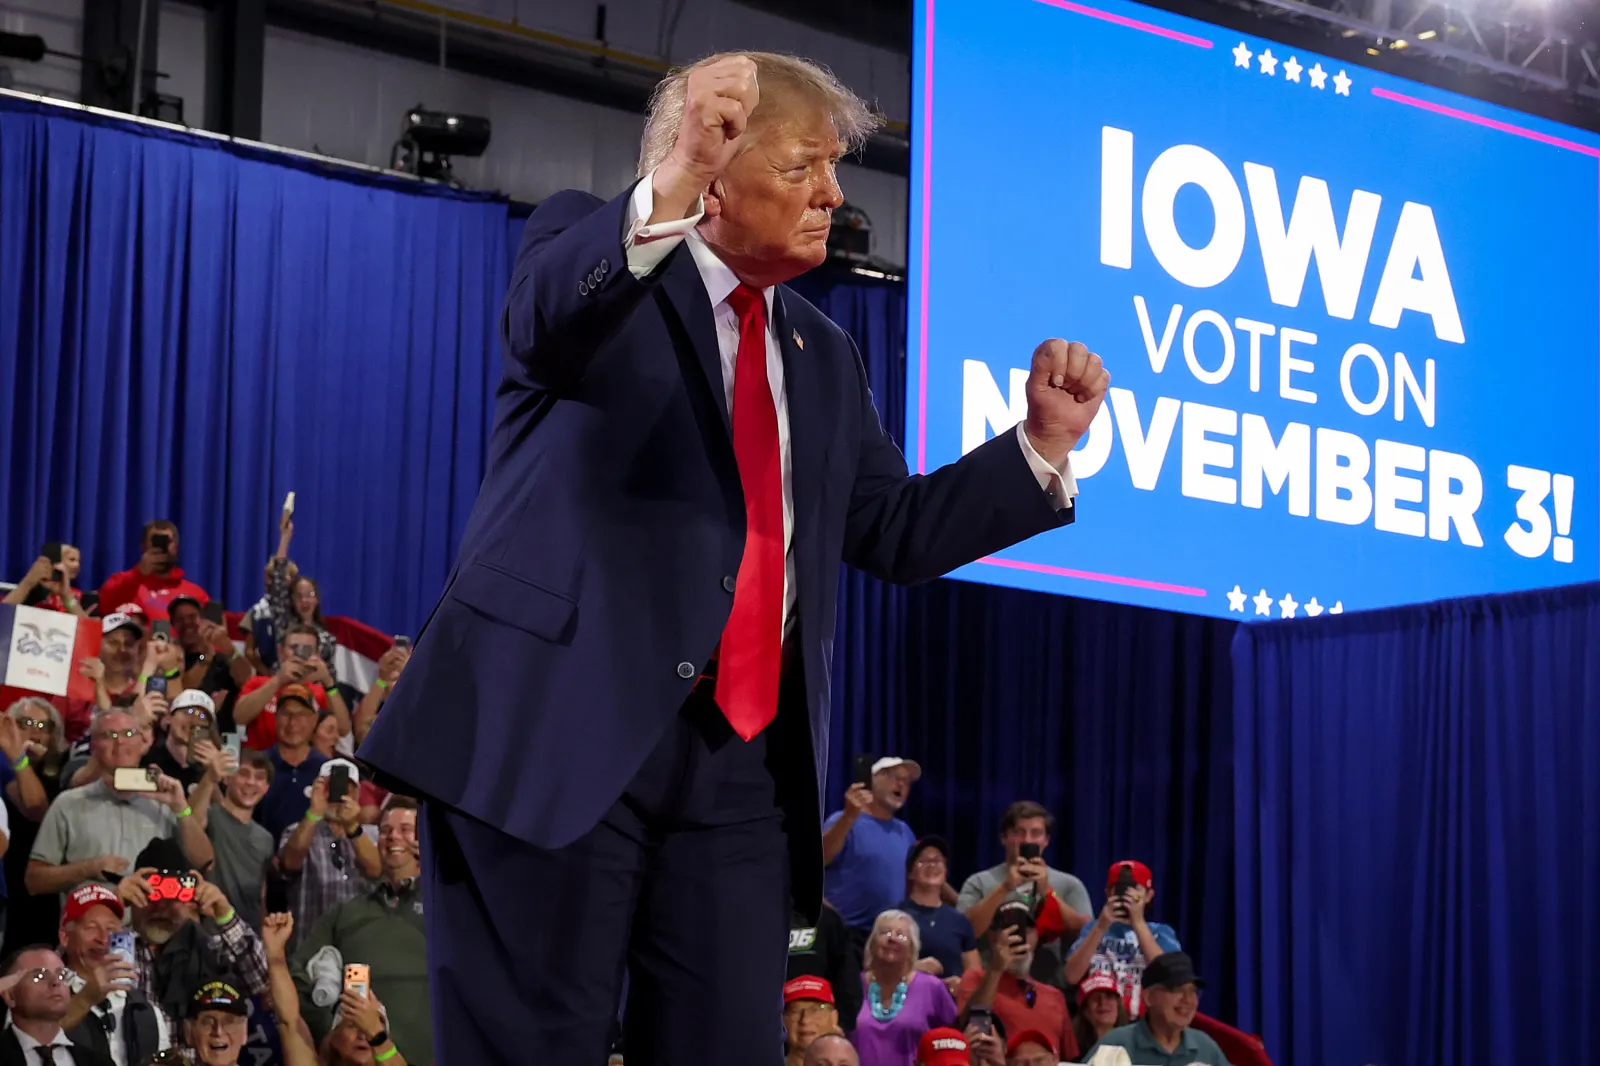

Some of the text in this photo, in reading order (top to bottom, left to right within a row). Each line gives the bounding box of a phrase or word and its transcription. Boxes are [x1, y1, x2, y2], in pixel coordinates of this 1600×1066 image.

[1100, 125, 1466, 344] IOWA
[1133, 295, 1435, 428] VOTE ON
[1504, 464, 1574, 563] 3!
[932, 1038, 967, 1051] TRUMP
